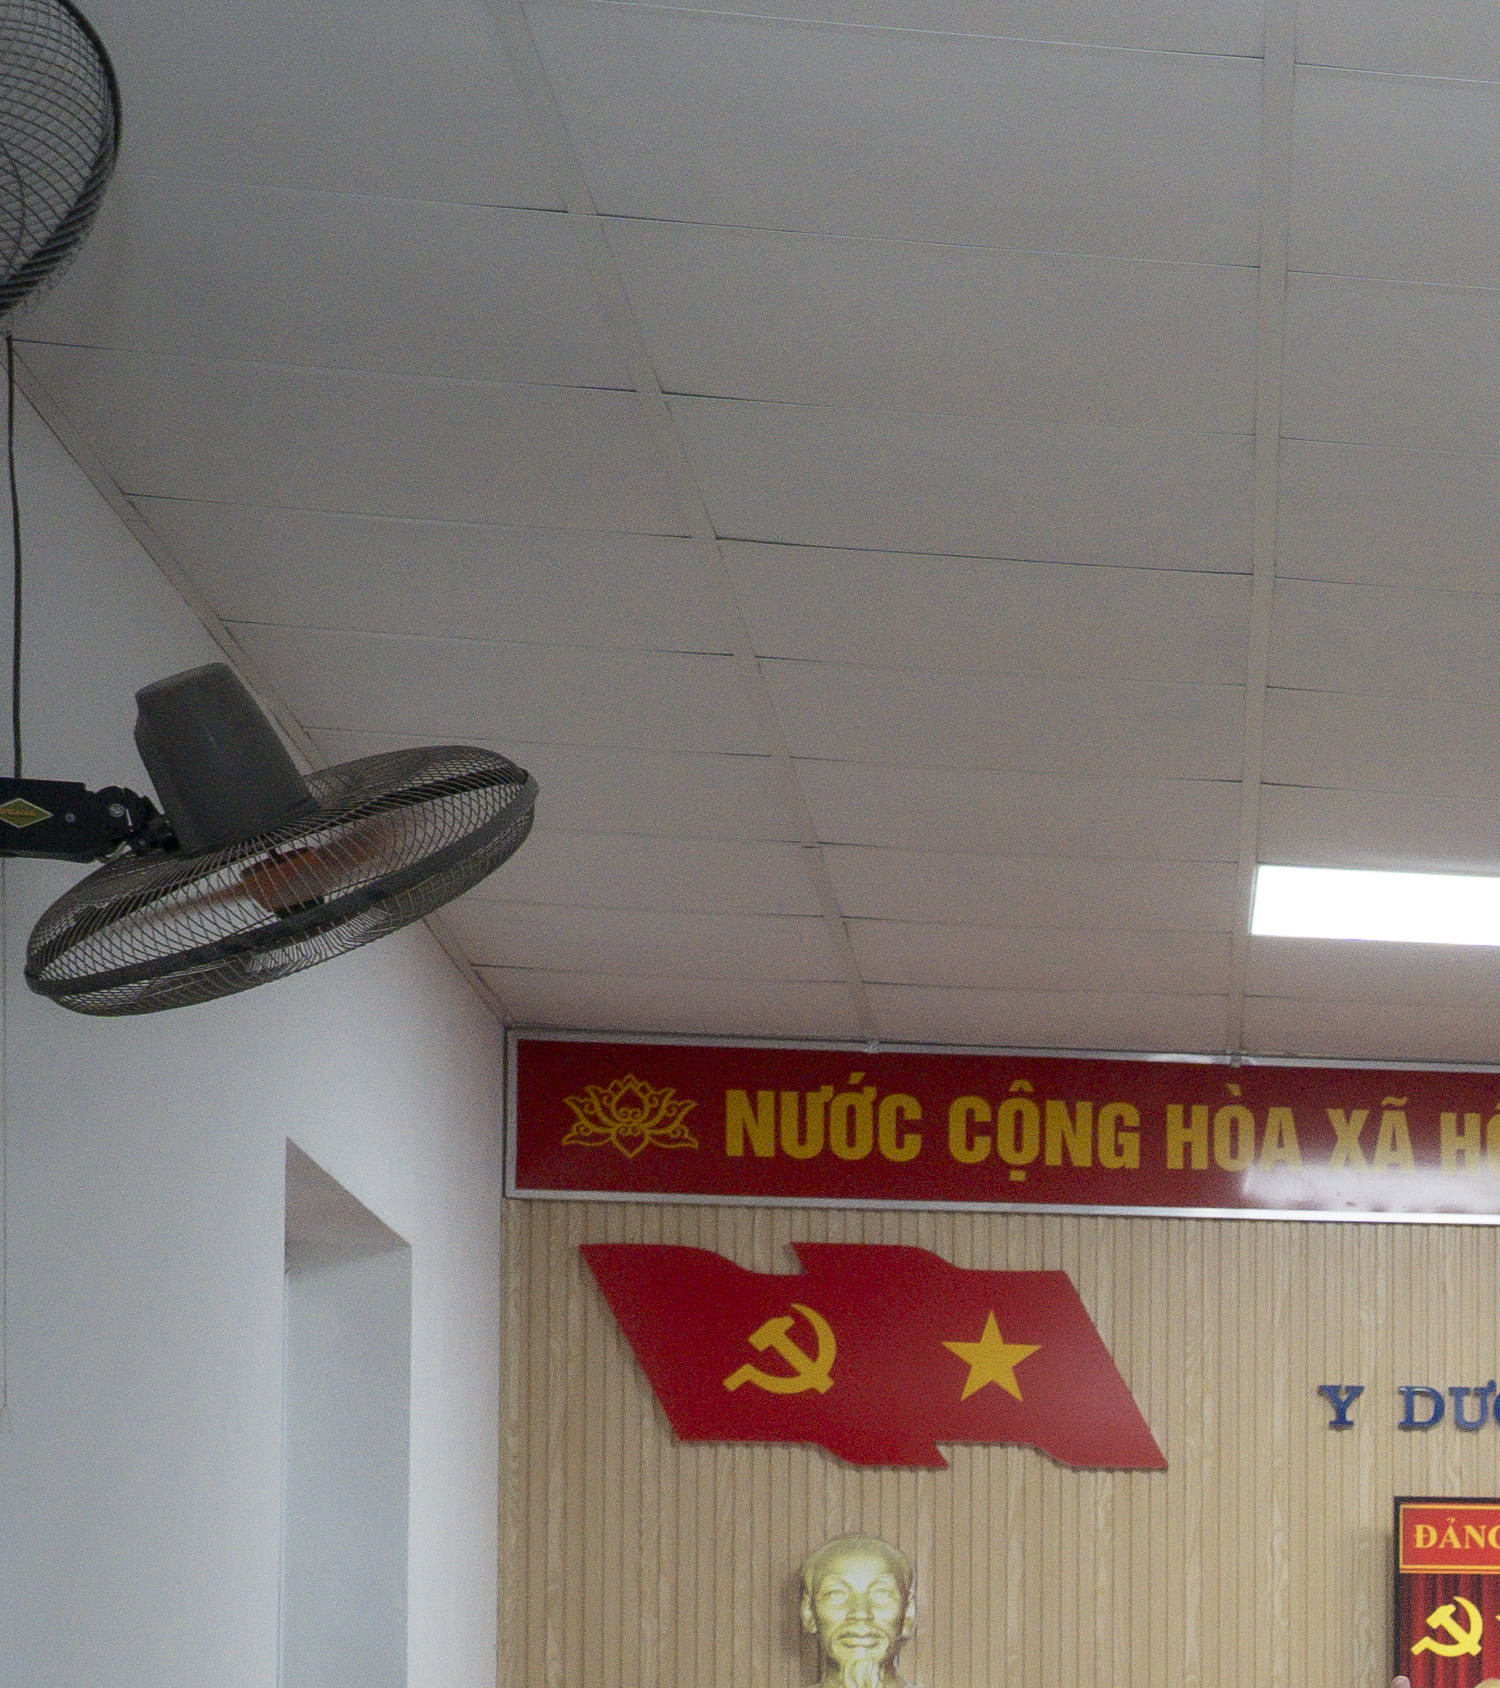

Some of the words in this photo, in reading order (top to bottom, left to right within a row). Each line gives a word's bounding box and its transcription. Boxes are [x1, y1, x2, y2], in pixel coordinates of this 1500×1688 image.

[725, 1071, 922, 1163] NƯỚC
[948, 1079, 1142, 1182] CỘNG
[1166, 1083, 1302, 1173] HÒA
[1326, 1096, 1416, 1175] XÃ
[1318, 1384, 1365, 1430] Y
